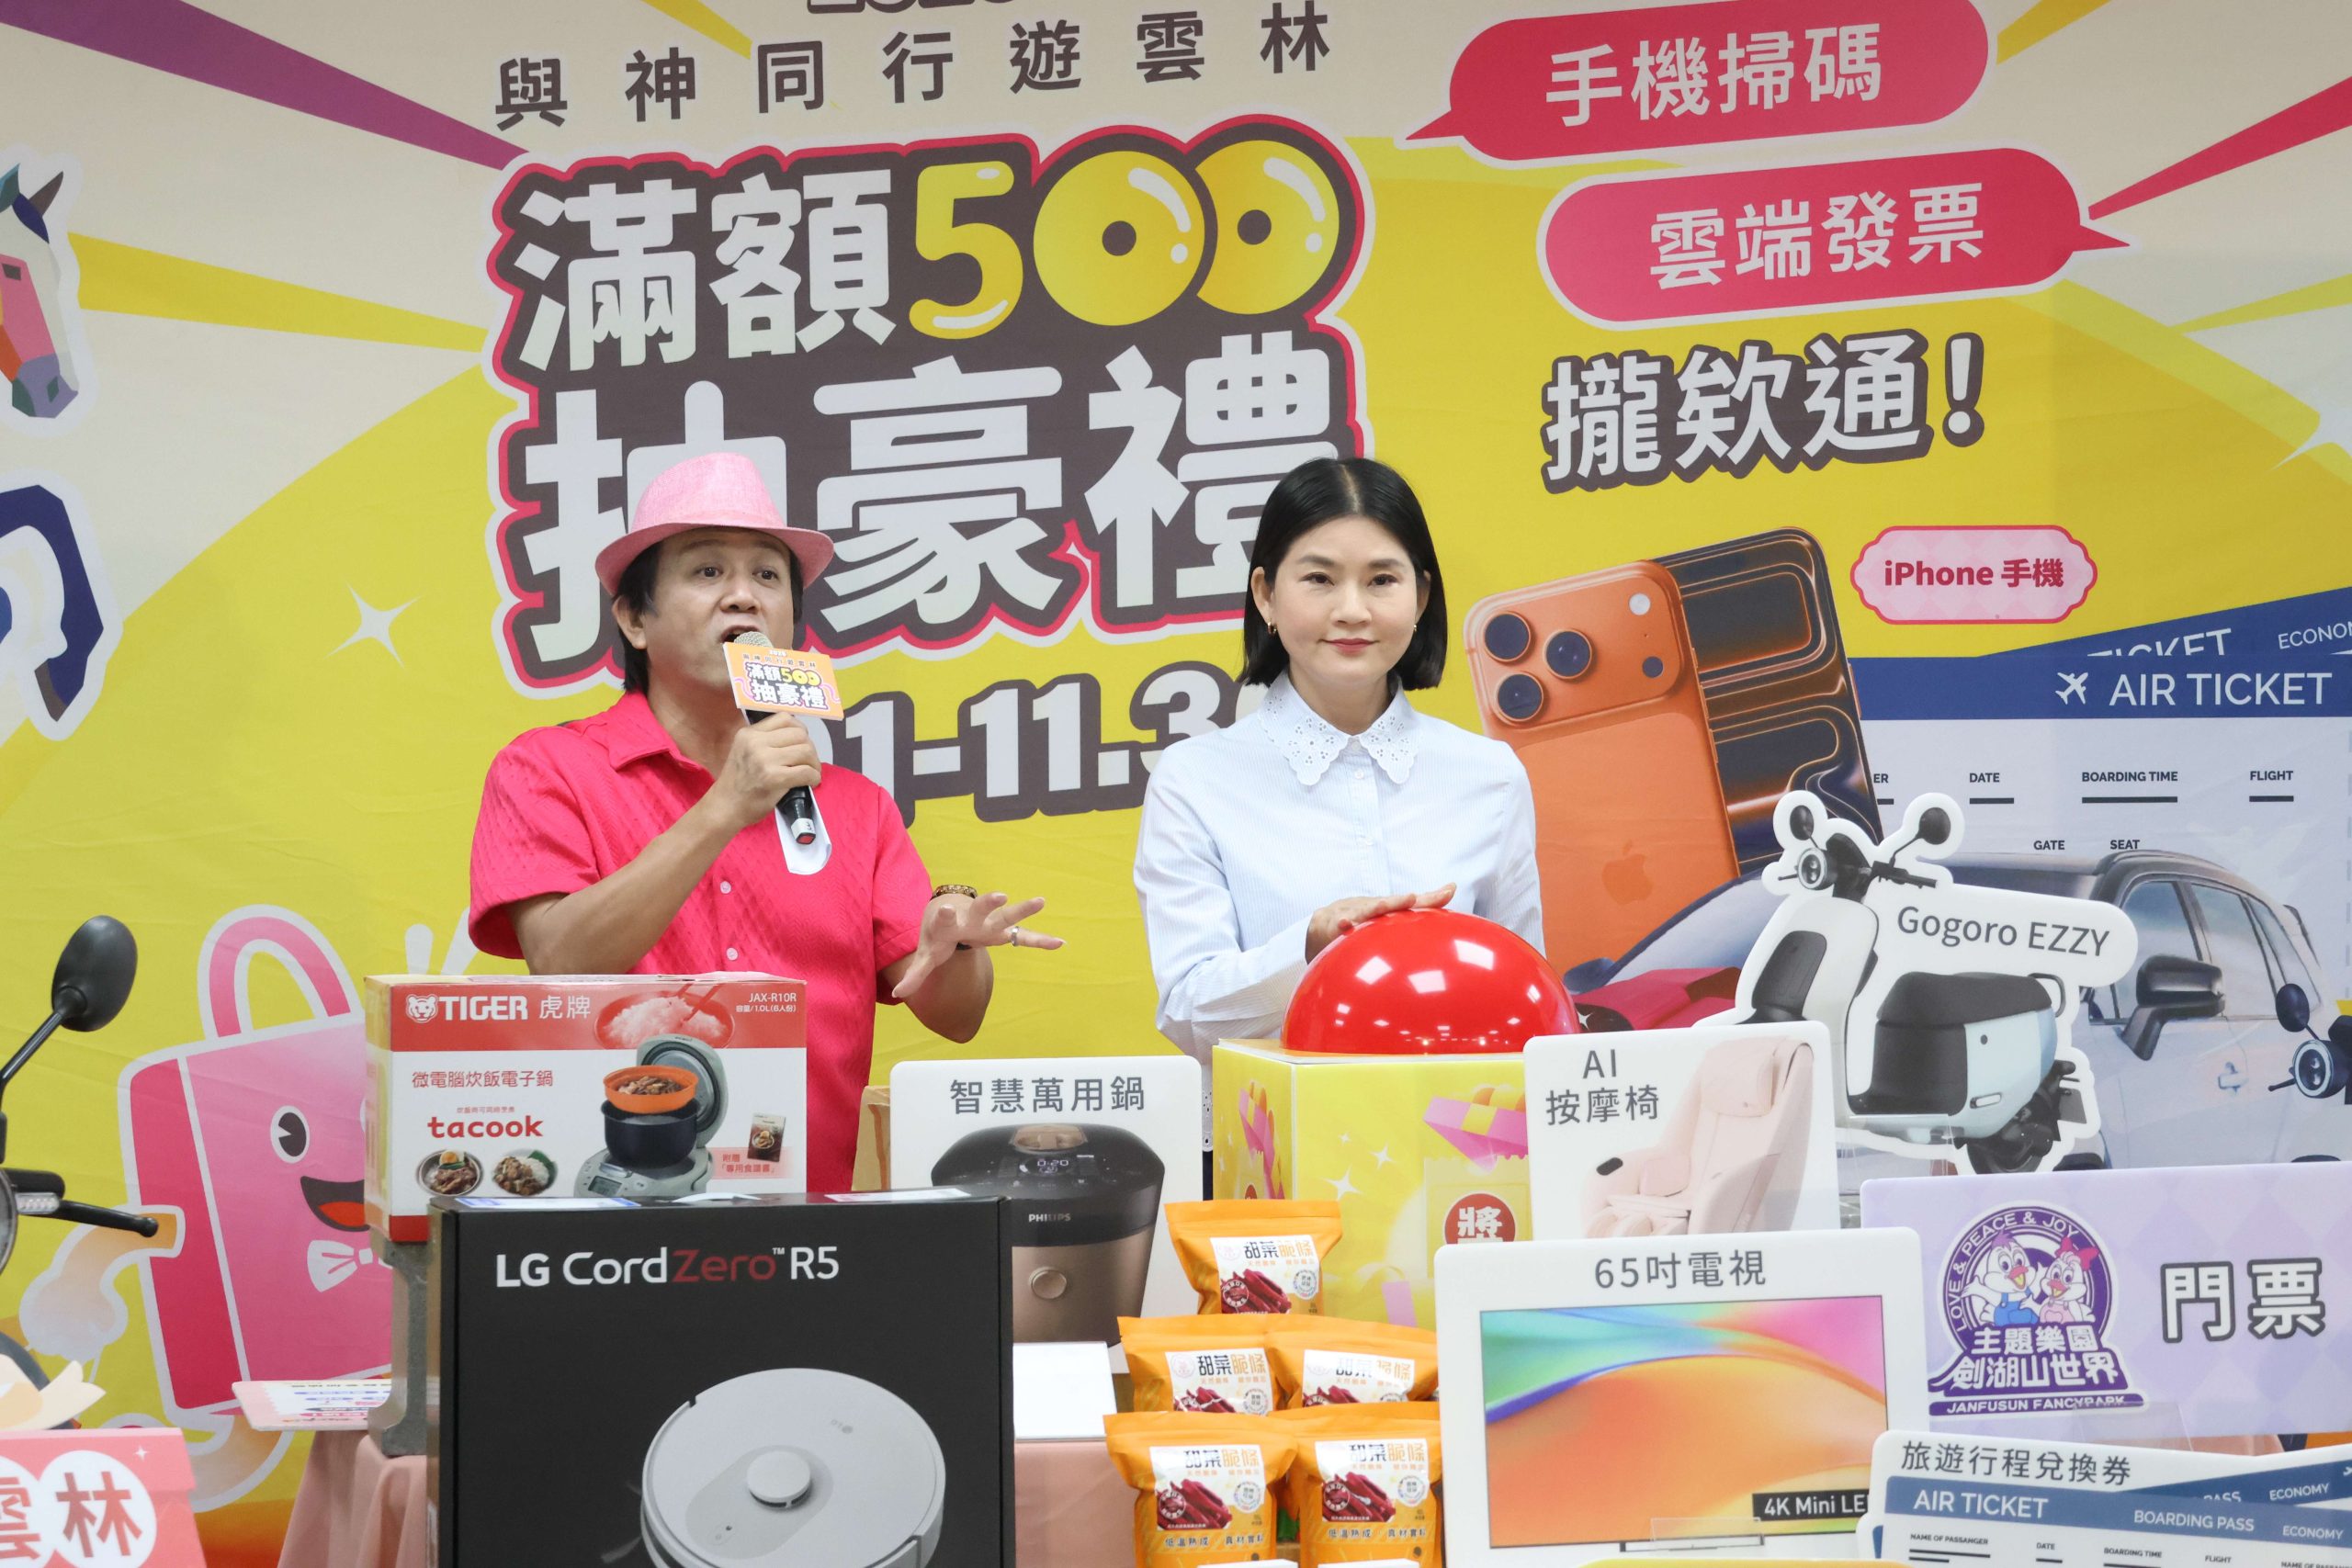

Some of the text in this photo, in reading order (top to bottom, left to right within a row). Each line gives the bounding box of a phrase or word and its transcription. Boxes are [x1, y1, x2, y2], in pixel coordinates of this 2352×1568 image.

[494, 4, 1331, 131] 與神同行遊雲林
[1544, 24, 1882, 126] 手機掃碼
[1649, 183, 1984, 289] 雲端發票
[514, 140, 1340, 371] 滿額500
[1884, 558, 2064, 588] iPhone 手機
[2109, 672, 2333, 706] AIR TICKET
[1969, 772, 2000, 783] DATE
[2082, 772, 2178, 783] BOARDING TIME
[2250, 771, 2293, 781] FLIGHT
[2033, 840, 2065, 851] GATE
[2109, 839, 2141, 850] SEAT
[1897, 906, 2110, 957] Gogoro EZZY
[439, 994, 592, 1021] TIGER 虎牌
[748, 992, 797, 1003] JAX-R10R
[1583, 1048, 1618, 1079] AI
[411, 1070, 554, 1089] 微電腦炊飯電子鍋
[950, 1076, 1145, 1115] 智慧萬用鍋
[1545, 1084, 1659, 1126] 按摩椅
[427, 1115, 544, 1139] tacook
[496, 1253, 550, 1288] LG
[790, 1247, 840, 1280] R5
[1594, 1250, 1766, 1289] 65吋電視
[1949, 1280, 1968, 1332] LOVE
[1962, 1213, 2018, 1257] PEACE
[2042, 1214, 2079, 1238] JOY
[2162, 1258, 2324, 1342] 門票
[1971, 1325, 2099, 1355] 主題樂園
[1946, 1399, 2029, 1415] JANFUSUN
[1900, 1439, 2132, 1486] 旅遊行程兌換券
[1913, 1489, 2049, 1519] AIR TICKET
[2269, 1483, 2330, 1501] ECONOMY
[1764, 1495, 1868, 1517] 4K Mini LE
[2133, 1509, 2255, 1532] BOARDING PASS
[2282, 1524, 2344, 1540] ECONOMY
[1910, 1533, 1932, 1542] NAME
[2036, 1542, 2056, 1551] DATE
[2103, 1547, 2163, 1559] BOARDING TIME
[2204, 1555, 2233, 1564] FLIGHT
